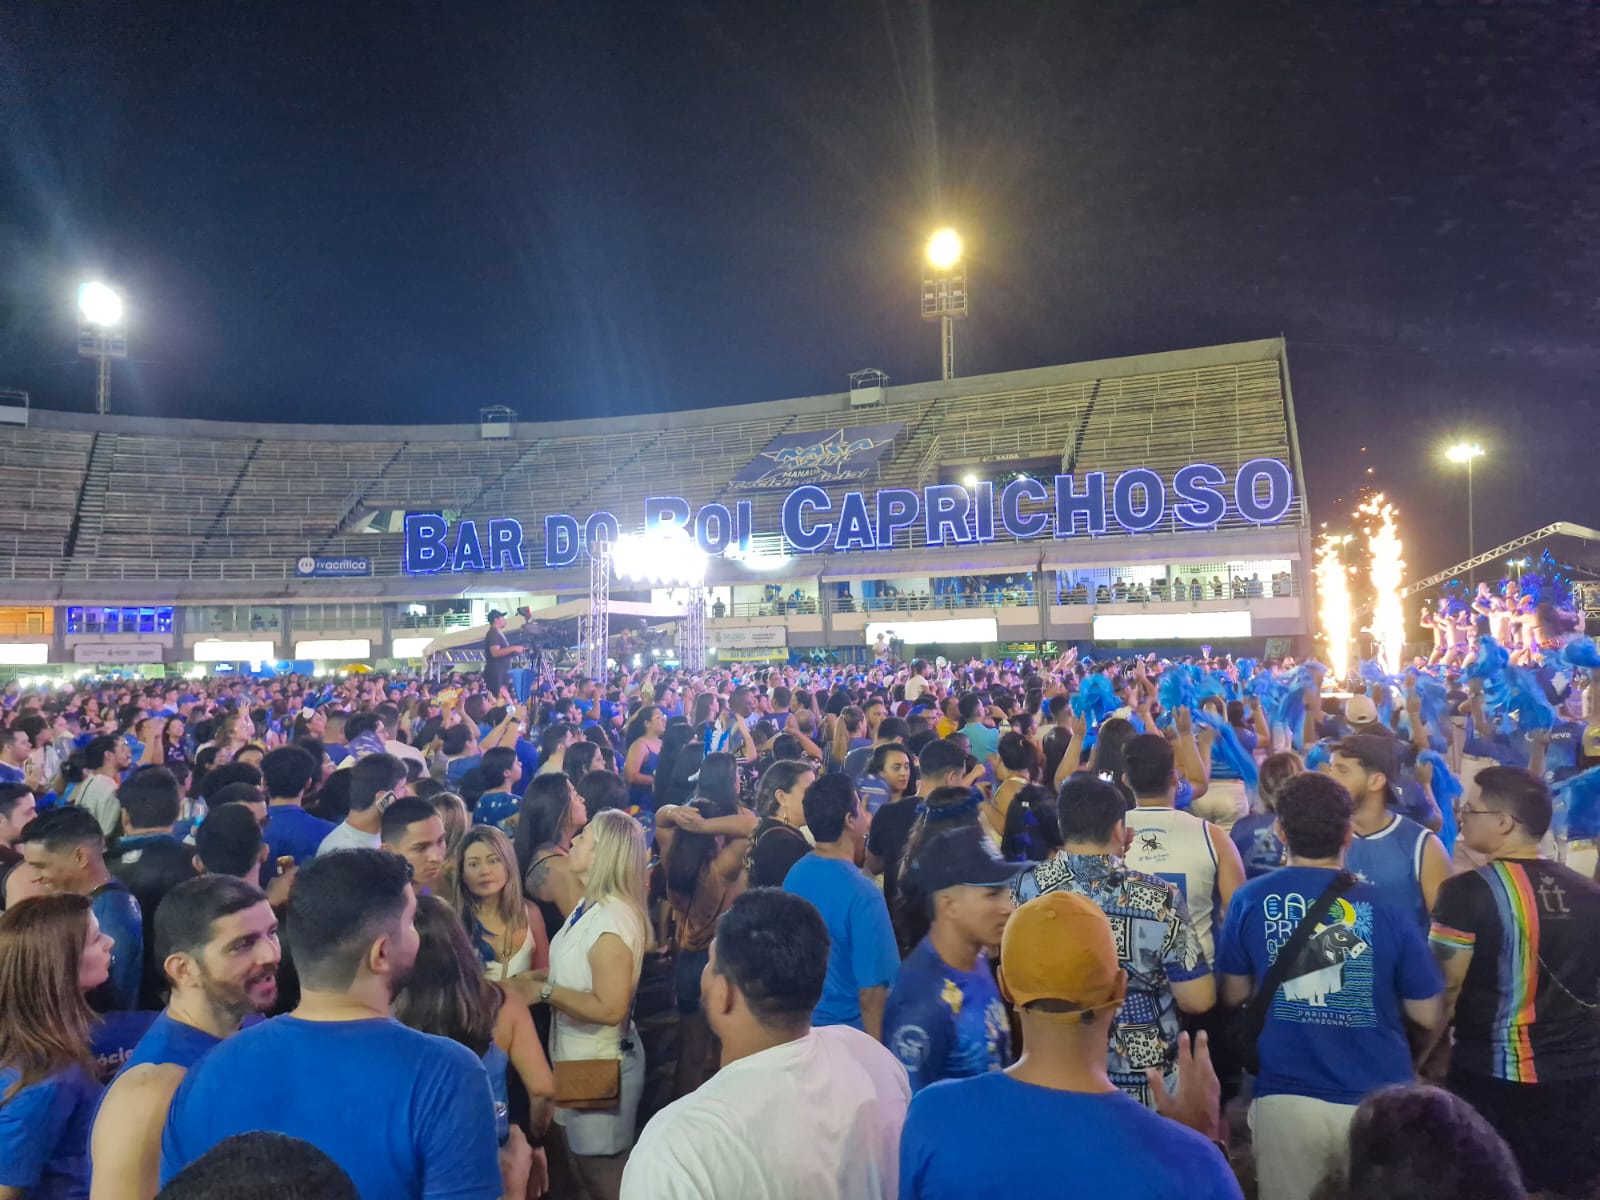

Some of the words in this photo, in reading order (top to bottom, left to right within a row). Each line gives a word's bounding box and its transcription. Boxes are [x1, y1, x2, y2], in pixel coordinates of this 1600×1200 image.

[405, 513, 525, 574] BAR
[544, 511, 620, 567] DO
[781, 457, 1293, 551] CAPRICHOSO
